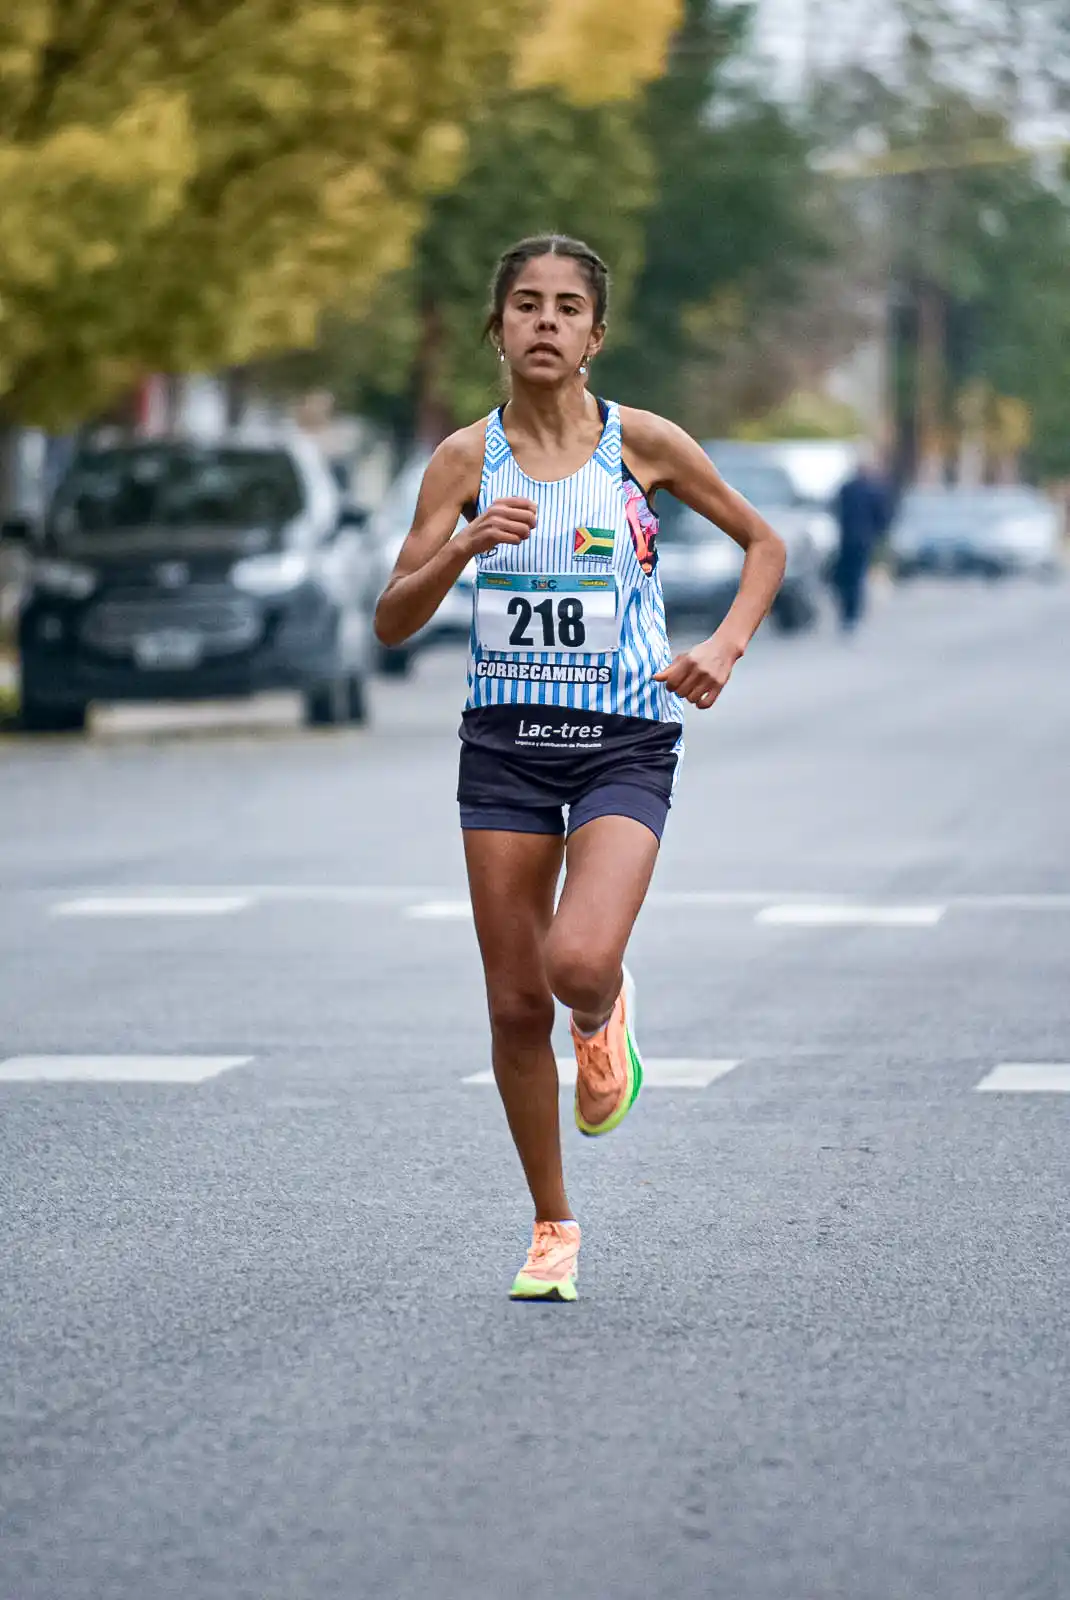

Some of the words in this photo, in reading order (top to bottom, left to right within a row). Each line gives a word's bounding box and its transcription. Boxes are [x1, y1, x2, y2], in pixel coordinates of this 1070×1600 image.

[507, 596, 585, 647] 218
[476, 661, 611, 683] CORRECAMINOS
[518, 719, 604, 738] Lac-tres
